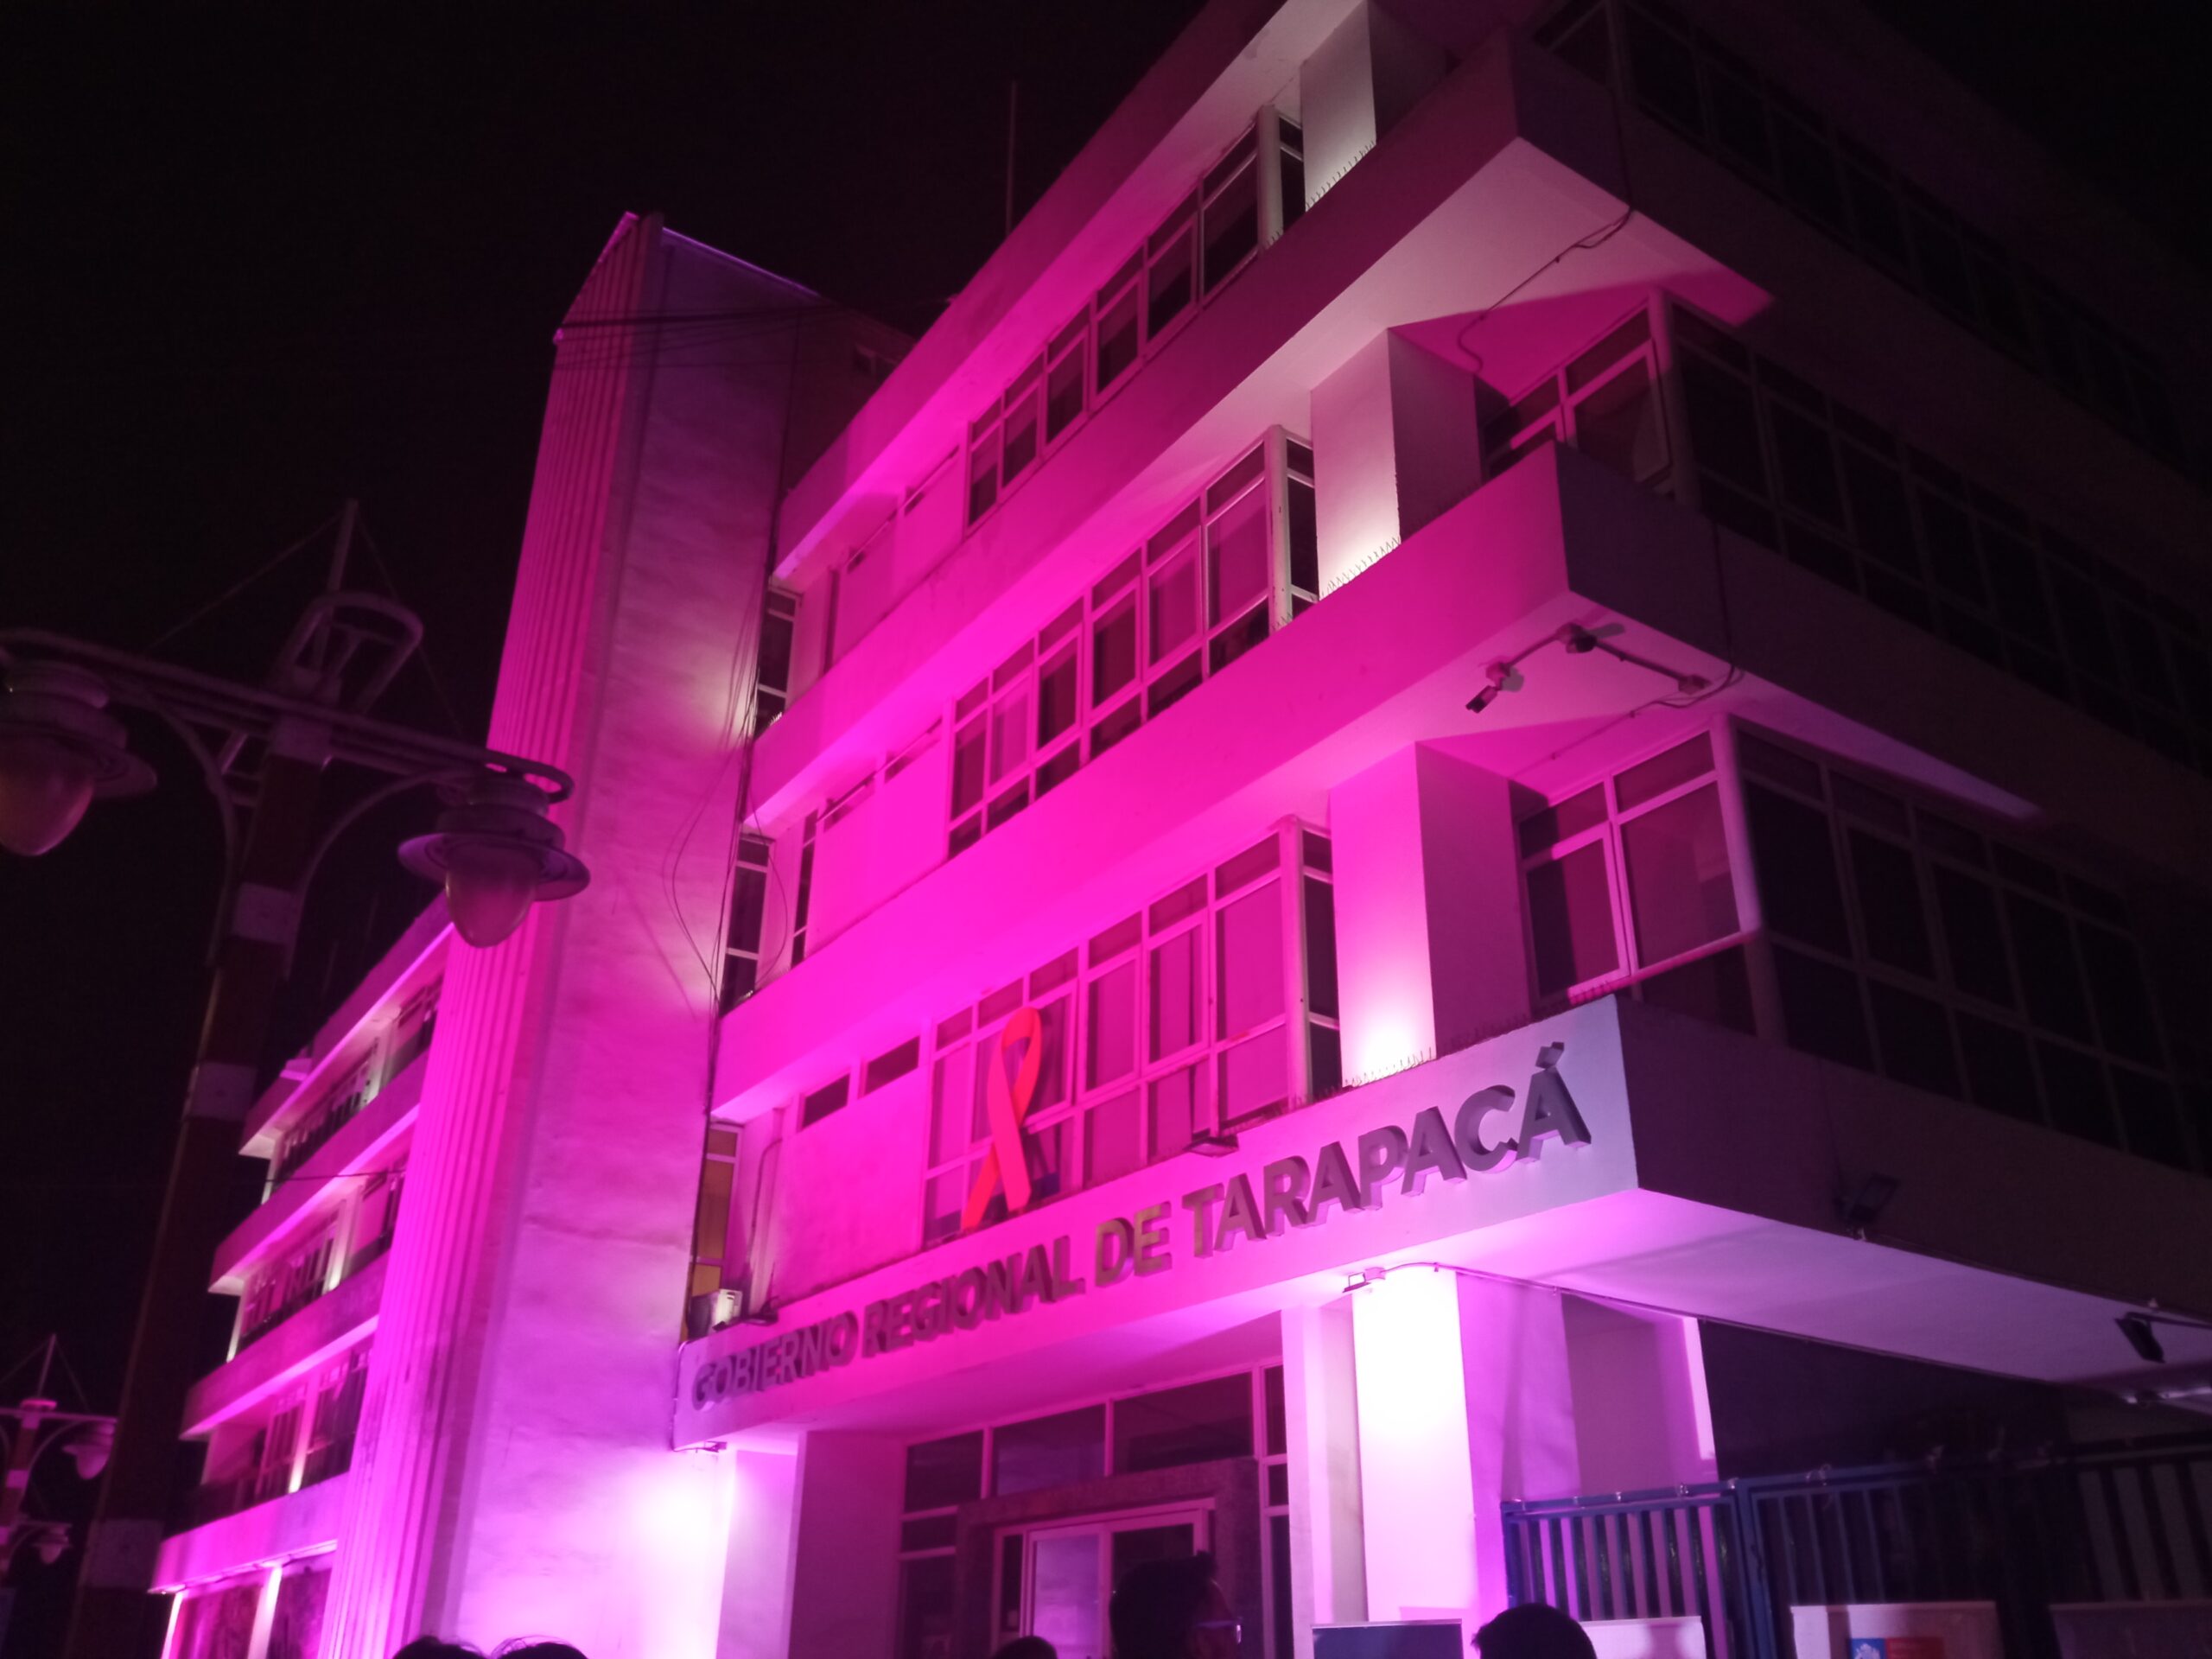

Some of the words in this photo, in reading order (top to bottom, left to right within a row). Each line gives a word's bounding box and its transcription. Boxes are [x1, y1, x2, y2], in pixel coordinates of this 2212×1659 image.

[692, 1311, 859, 1410] GOBIERNO
[862, 1235, 1086, 1357] REGIONAL
[1095, 1200, 1172, 1287] DE
[1181, 1041, 1592, 1258] TARAPACÁ
